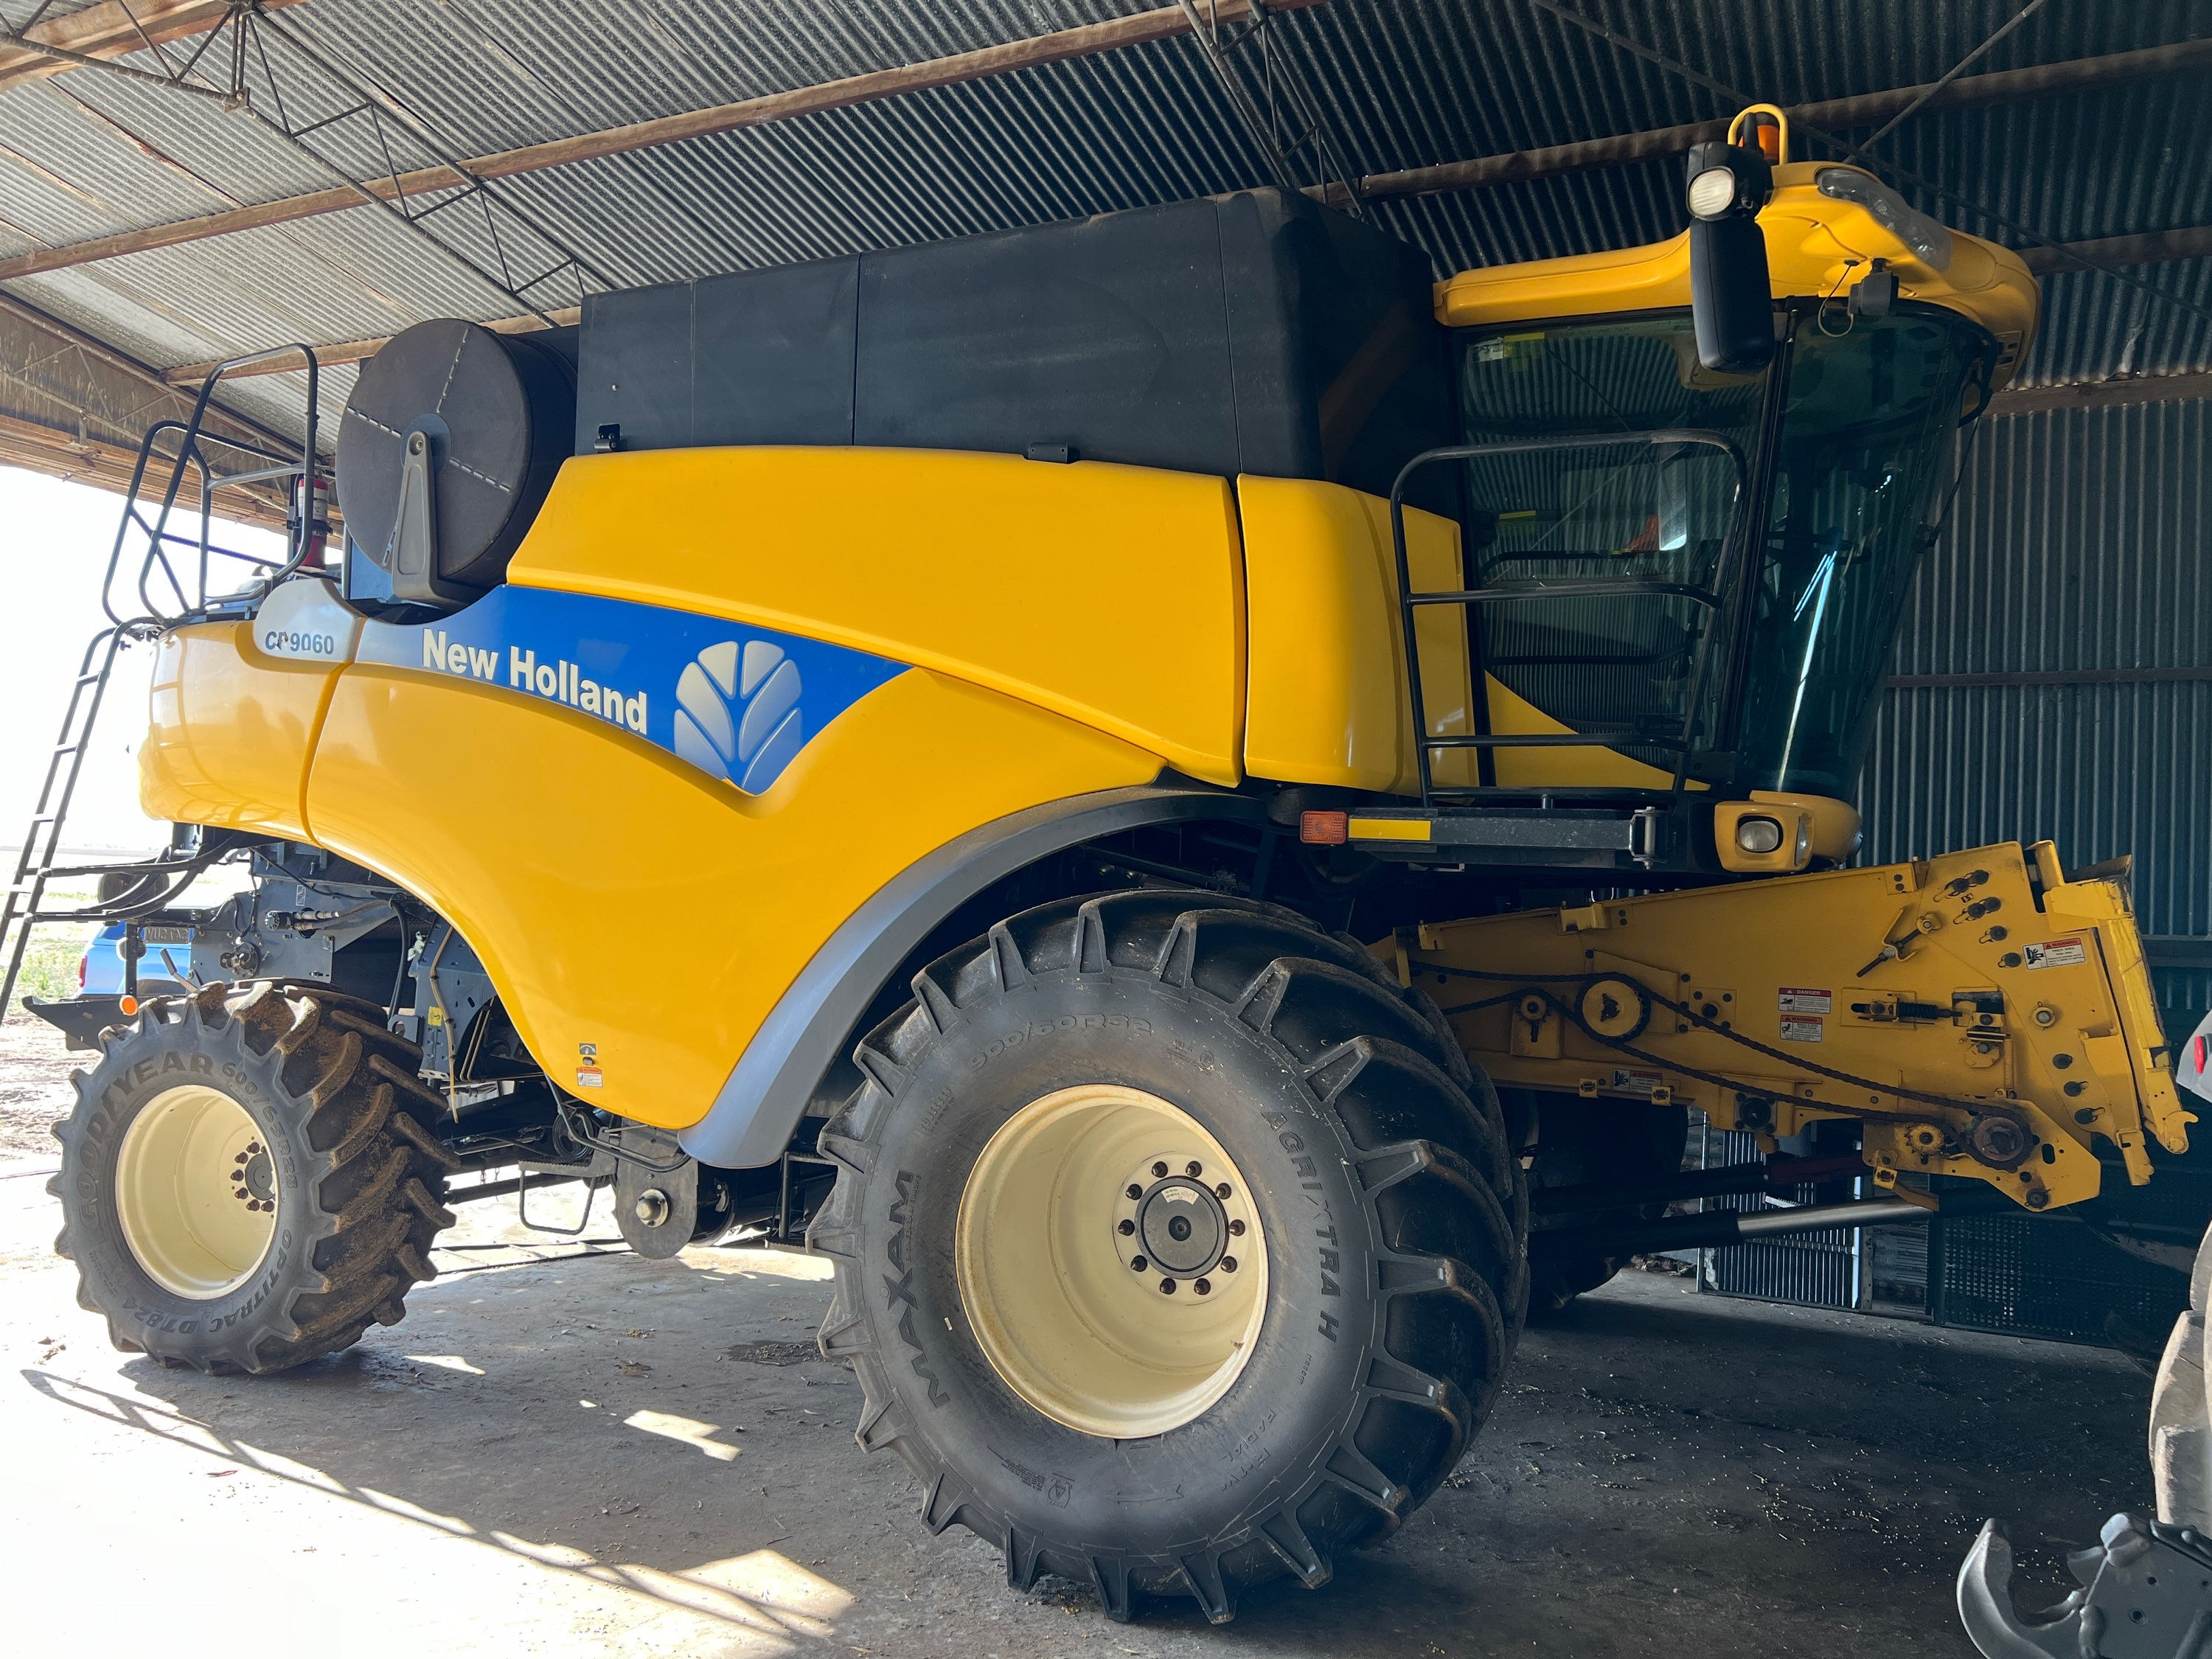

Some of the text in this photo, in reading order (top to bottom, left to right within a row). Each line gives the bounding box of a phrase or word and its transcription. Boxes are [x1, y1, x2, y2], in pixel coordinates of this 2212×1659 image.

[422, 628, 647, 734] New Holland
[77, 1050, 214, 1230] GOODYEAR
[1261, 1111, 1340, 1343] AGRIXTRA H
[122, 1228, 292, 1335] OPTITRAC DT824
[883, 1169, 950, 1408] MAXAM
